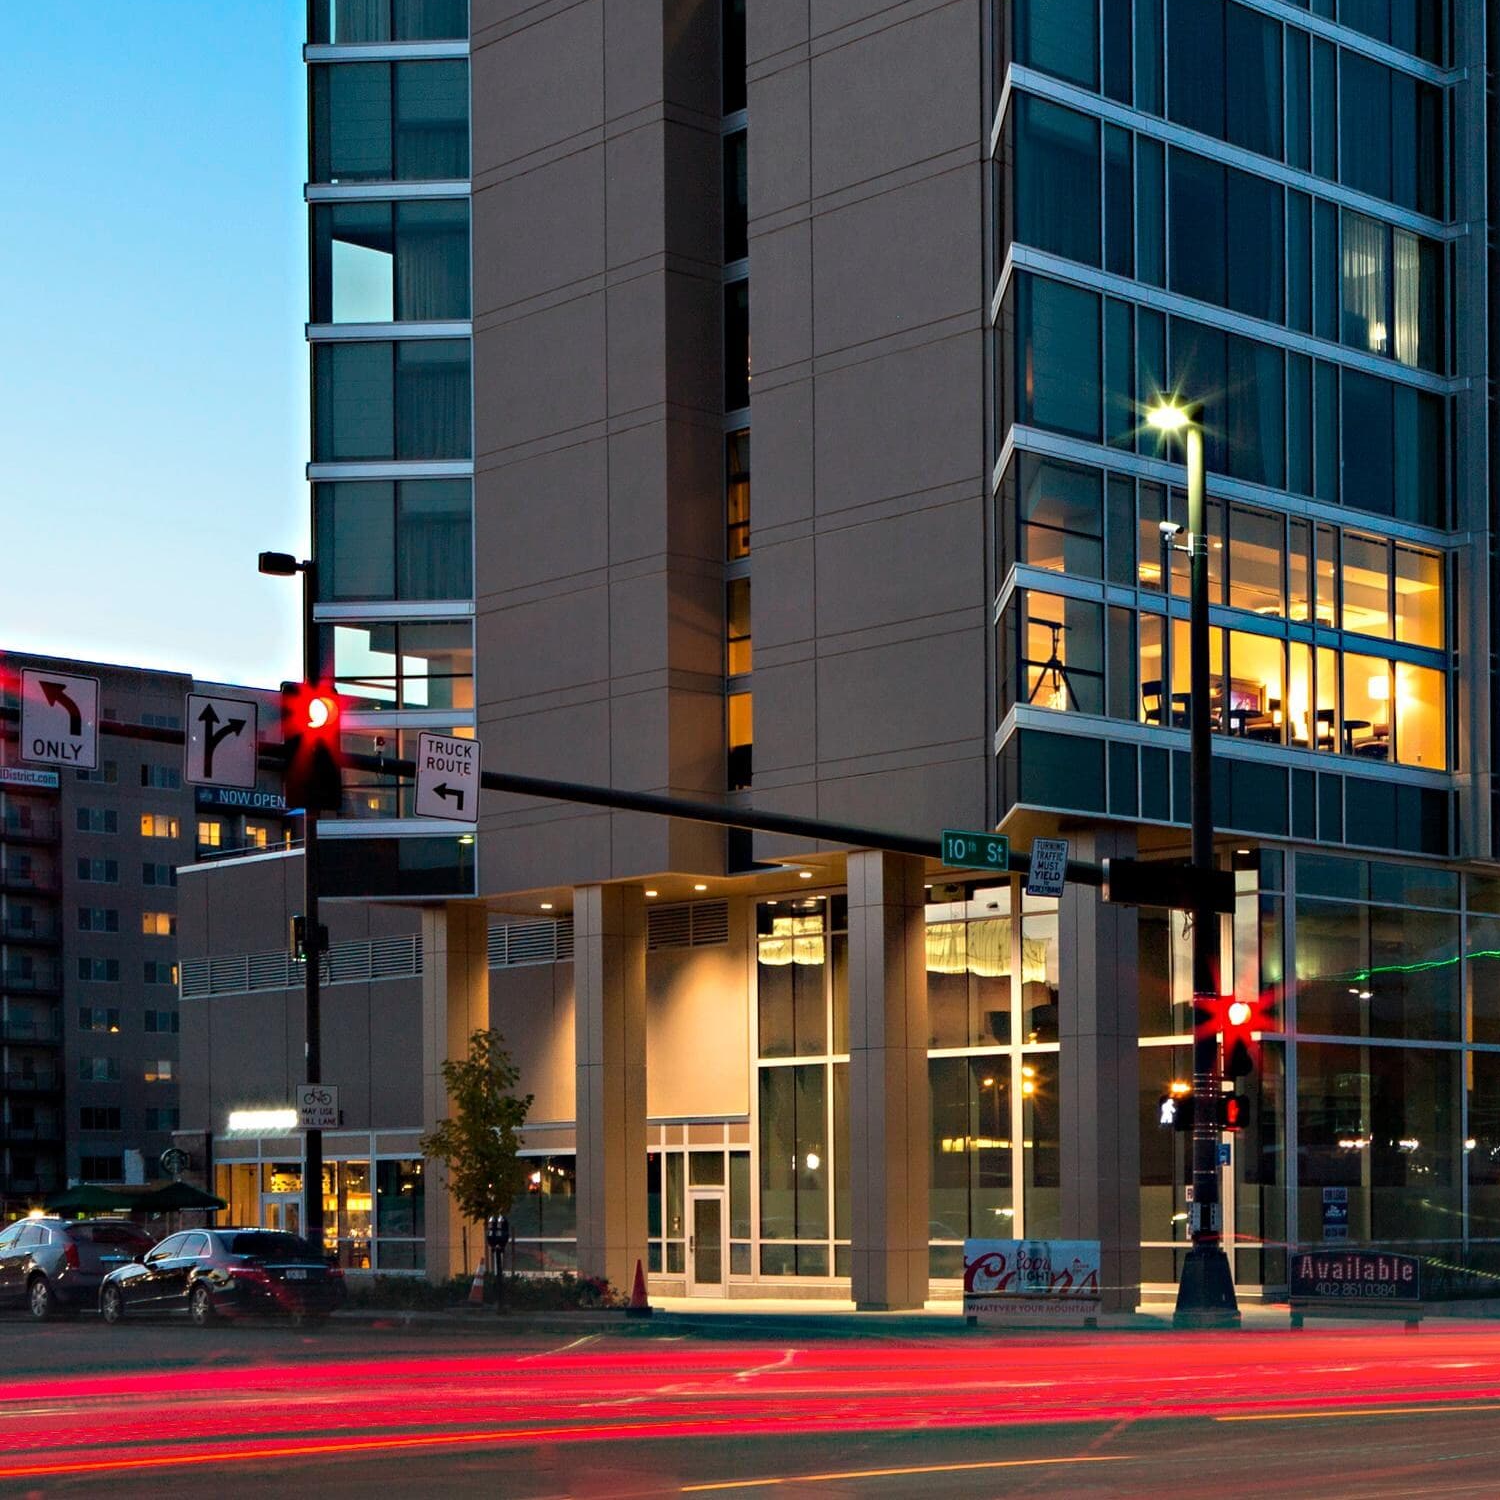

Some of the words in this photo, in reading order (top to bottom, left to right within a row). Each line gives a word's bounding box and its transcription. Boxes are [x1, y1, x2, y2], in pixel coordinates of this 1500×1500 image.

[33, 739, 82, 760] ONLY
[428, 740, 472, 758] TRUCK
[427, 757, 471, 775] ROUTE
[220, 790, 250, 805] NOW
[254, 793, 286, 808] OPEN
[987, 843, 1003, 862] St
[1037, 861, 1059, 870] MUST
[1034, 871, 1060, 880] YIELD
[1301, 1256, 1413, 1281] Available
[968, 1303, 1016, 1312] WHATEVER
[1019, 1304, 1044, 1313] YOUR
